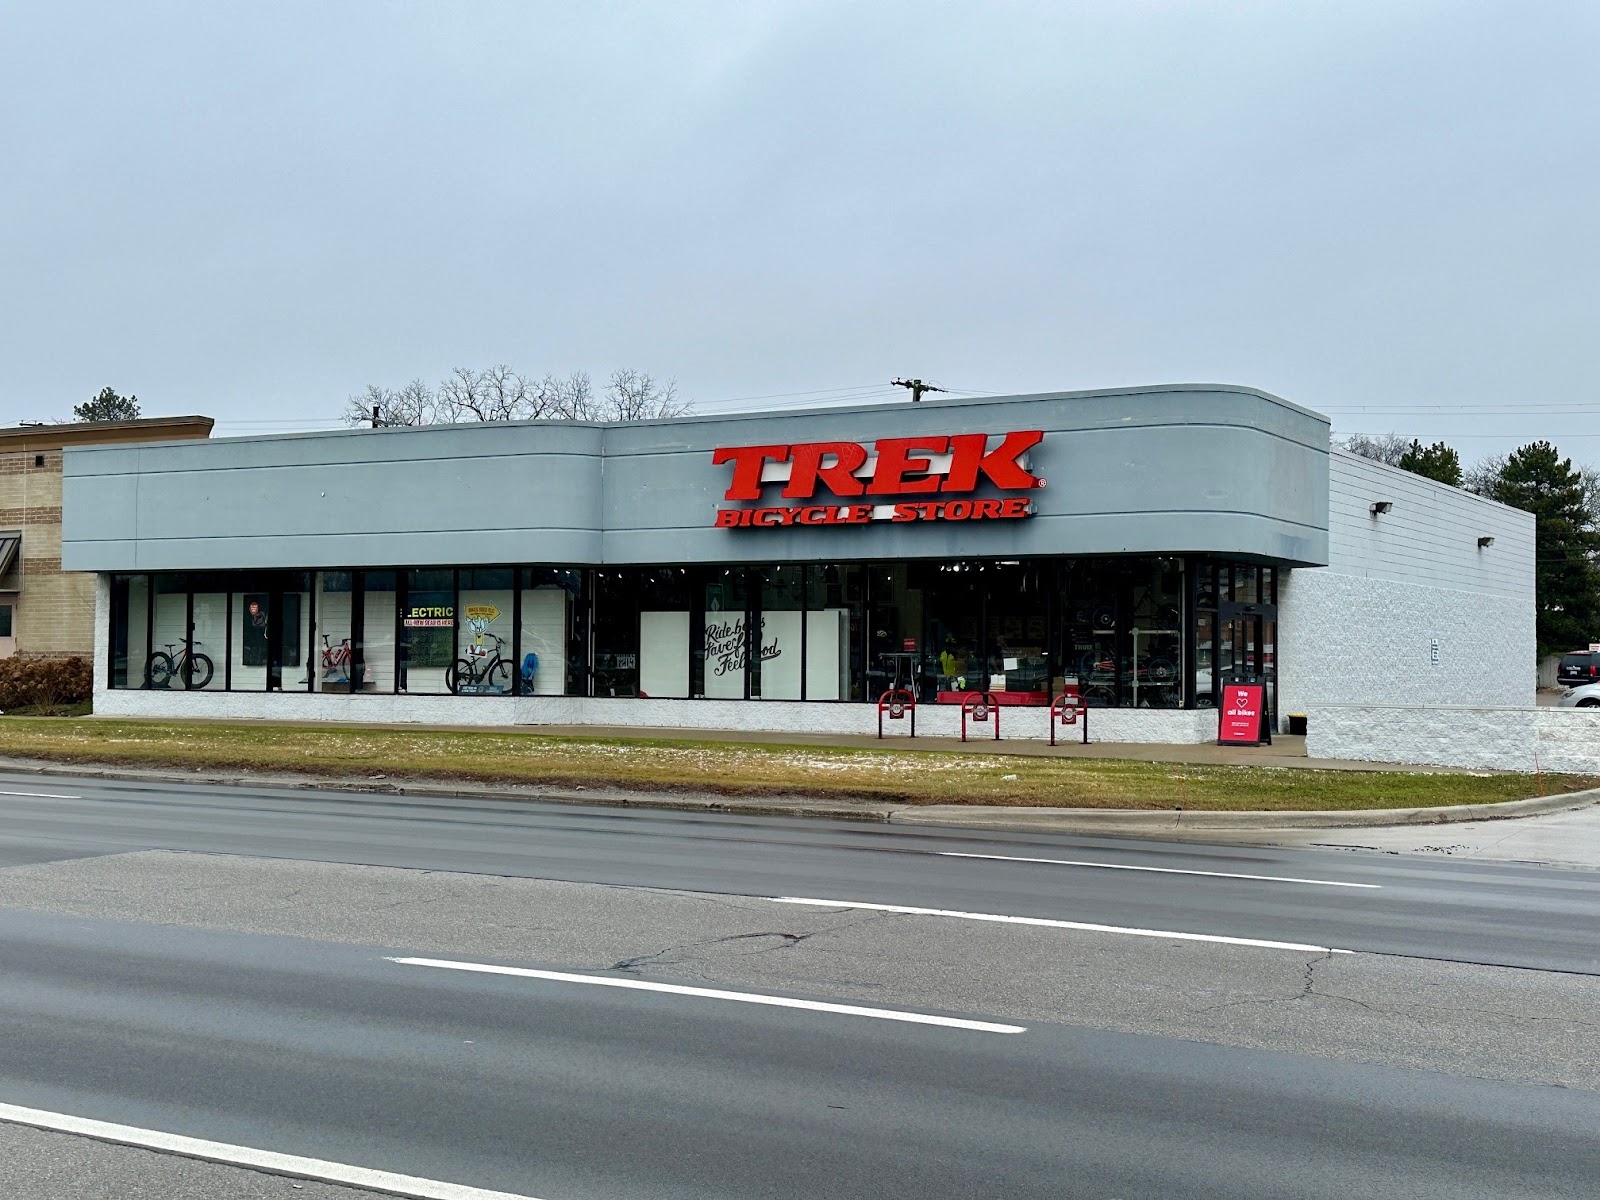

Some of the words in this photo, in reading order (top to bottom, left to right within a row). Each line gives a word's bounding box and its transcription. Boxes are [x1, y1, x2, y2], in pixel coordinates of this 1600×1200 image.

[712, 430, 1043, 500] TREK
[714, 504, 874, 527] BICYCLE
[892, 498, 1030, 523] STORE
[400, 607, 454, 618] ECTRIC
[705, 621, 735, 645] Ride
[761, 637, 781, 661] od
